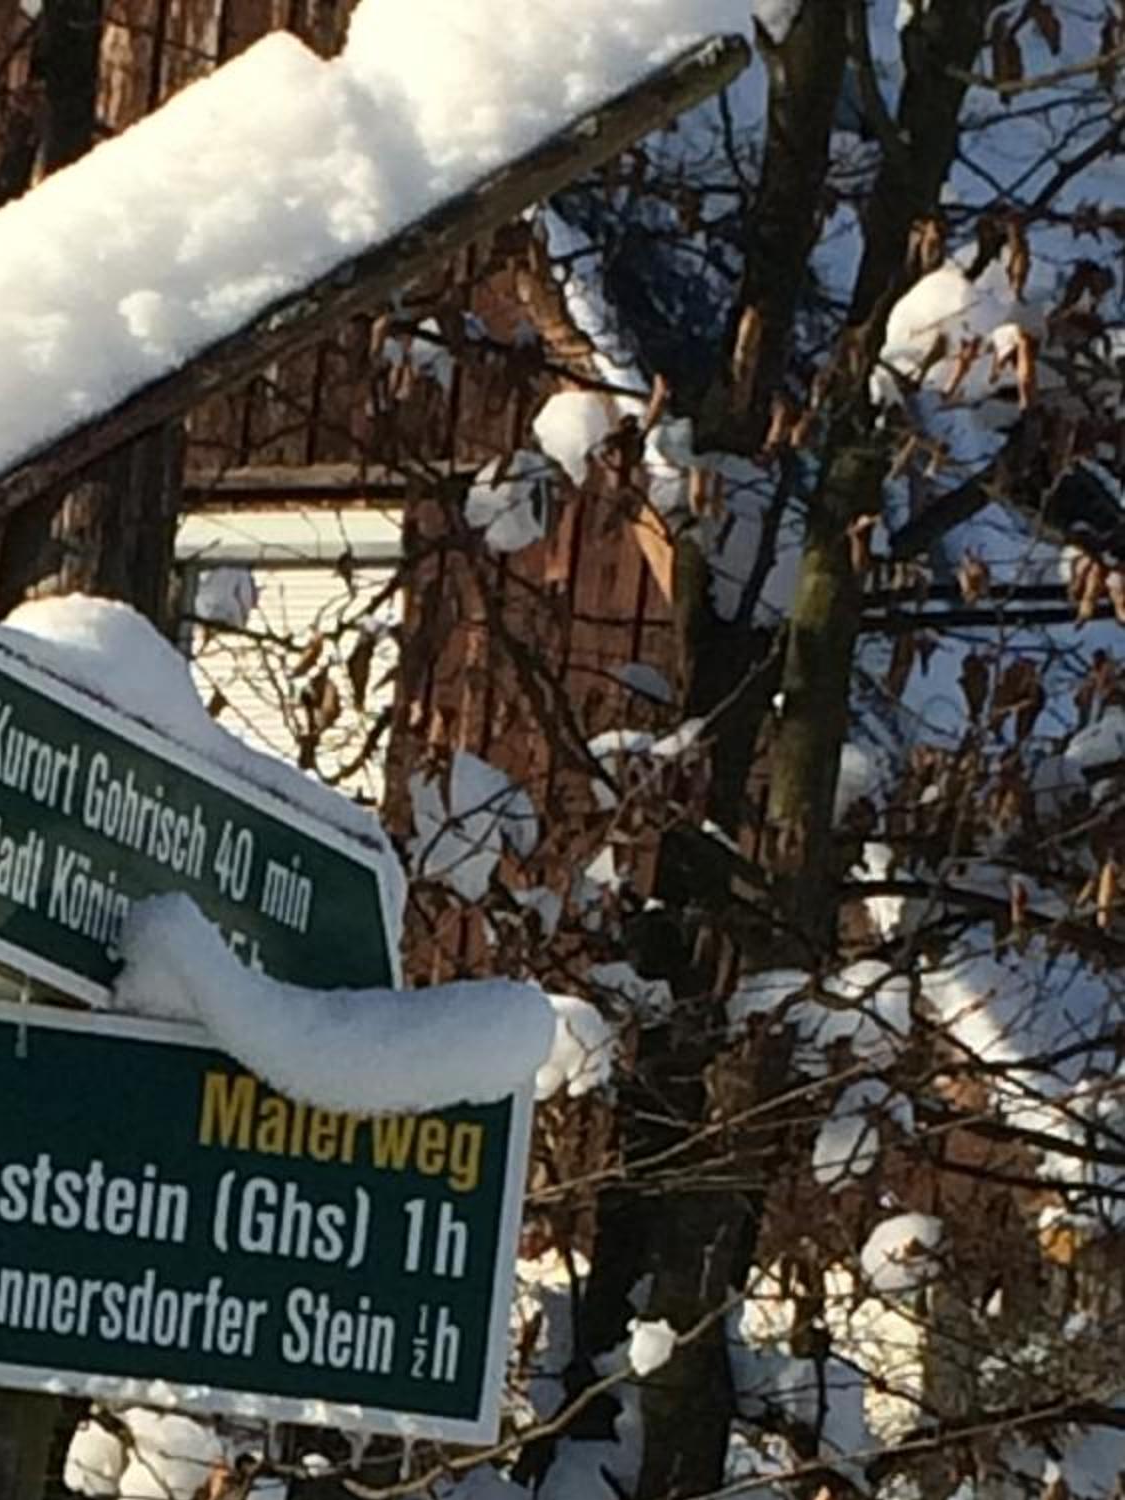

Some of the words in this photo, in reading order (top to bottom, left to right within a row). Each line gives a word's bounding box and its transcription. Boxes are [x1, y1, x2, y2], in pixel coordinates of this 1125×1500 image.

[83, 752, 207, 880] Gohrisch
[214, 820, 254, 901] 40
[260, 854, 313, 933] min
[212, 1170, 370, 1268] (Ghs)
[281, 1287, 395, 1374] Stein
